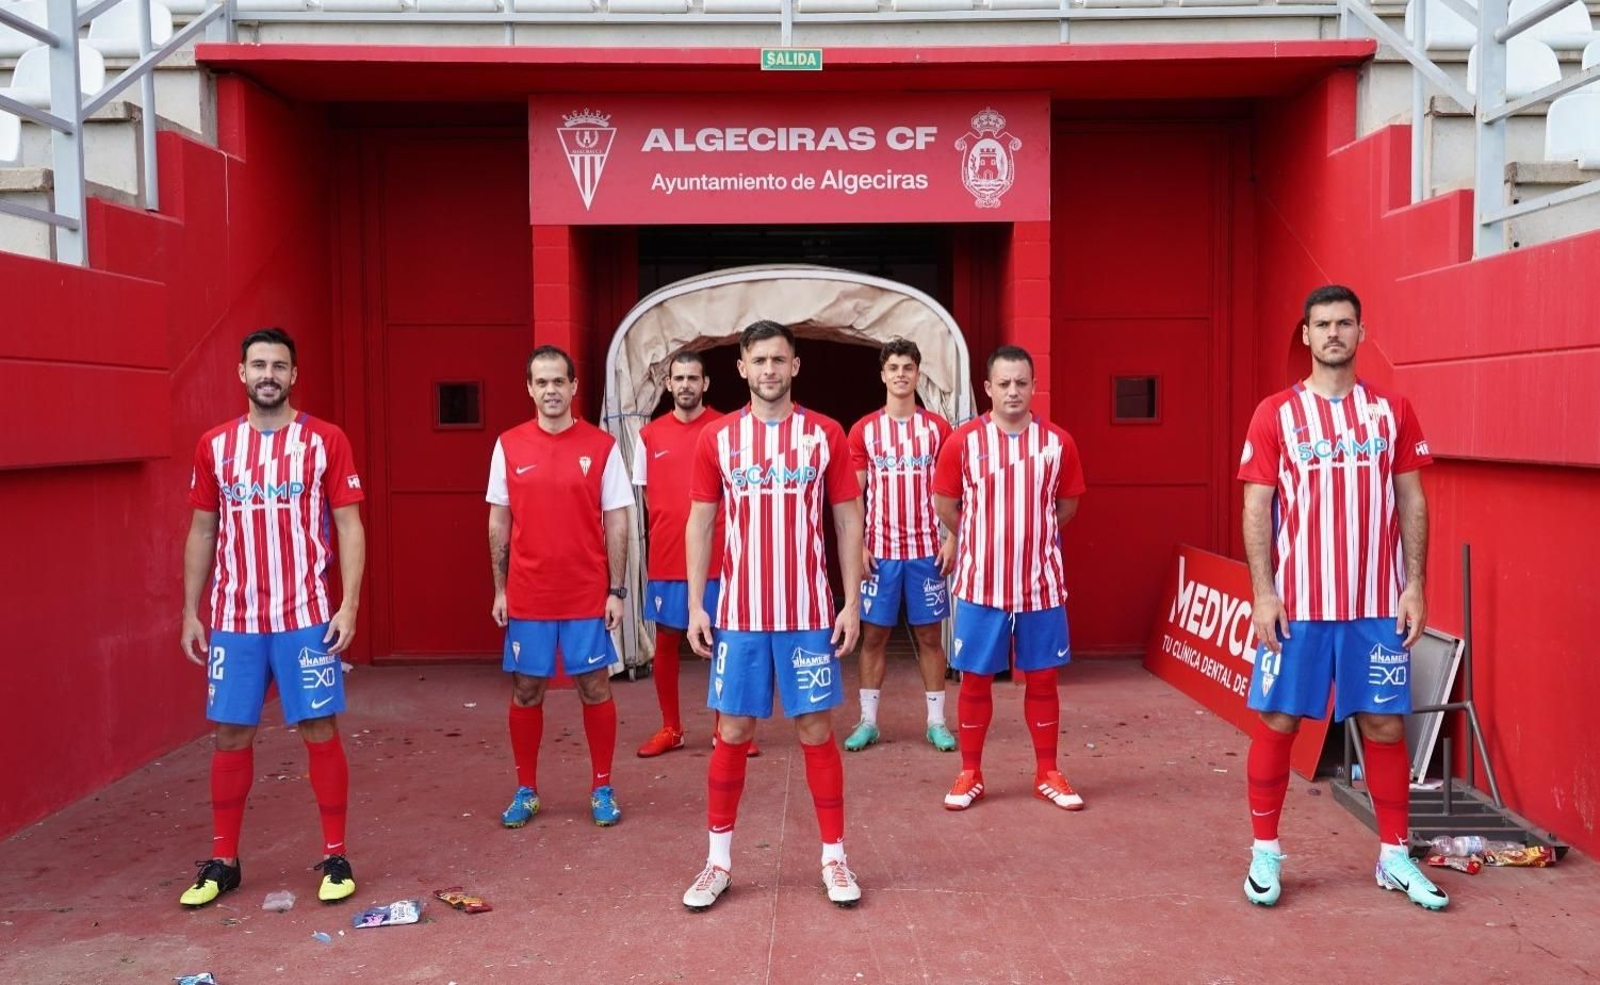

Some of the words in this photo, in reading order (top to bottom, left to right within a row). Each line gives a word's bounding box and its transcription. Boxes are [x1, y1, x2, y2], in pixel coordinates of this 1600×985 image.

[767, 52, 816, 66] SALIDA
[641, 127, 876, 151] ALGECIRAS
[886, 126, 937, 151] CF
[651, 173, 787, 194] Ayuntamiento
[791, 173, 815, 190] de
[820, 169, 929, 194] Algeciras
[1297, 437, 1387, 461] SCAMP
[875, 454, 932, 468] SCAMP
[732, 465, 816, 487] SCAMP
[222, 481, 304, 501] SCAMP
[716, 641, 728, 674] 8
[1162, 635, 1173, 653] TU
[1172, 640, 1201, 670] CLÍNICA
[1200, 656, 1232, 689] DENTAL
[1232, 673, 1248, 697] DE
[302, 667, 335, 689] EXO
[796, 667, 831, 689] EXO
[1369, 666, 1406, 685] EXO
